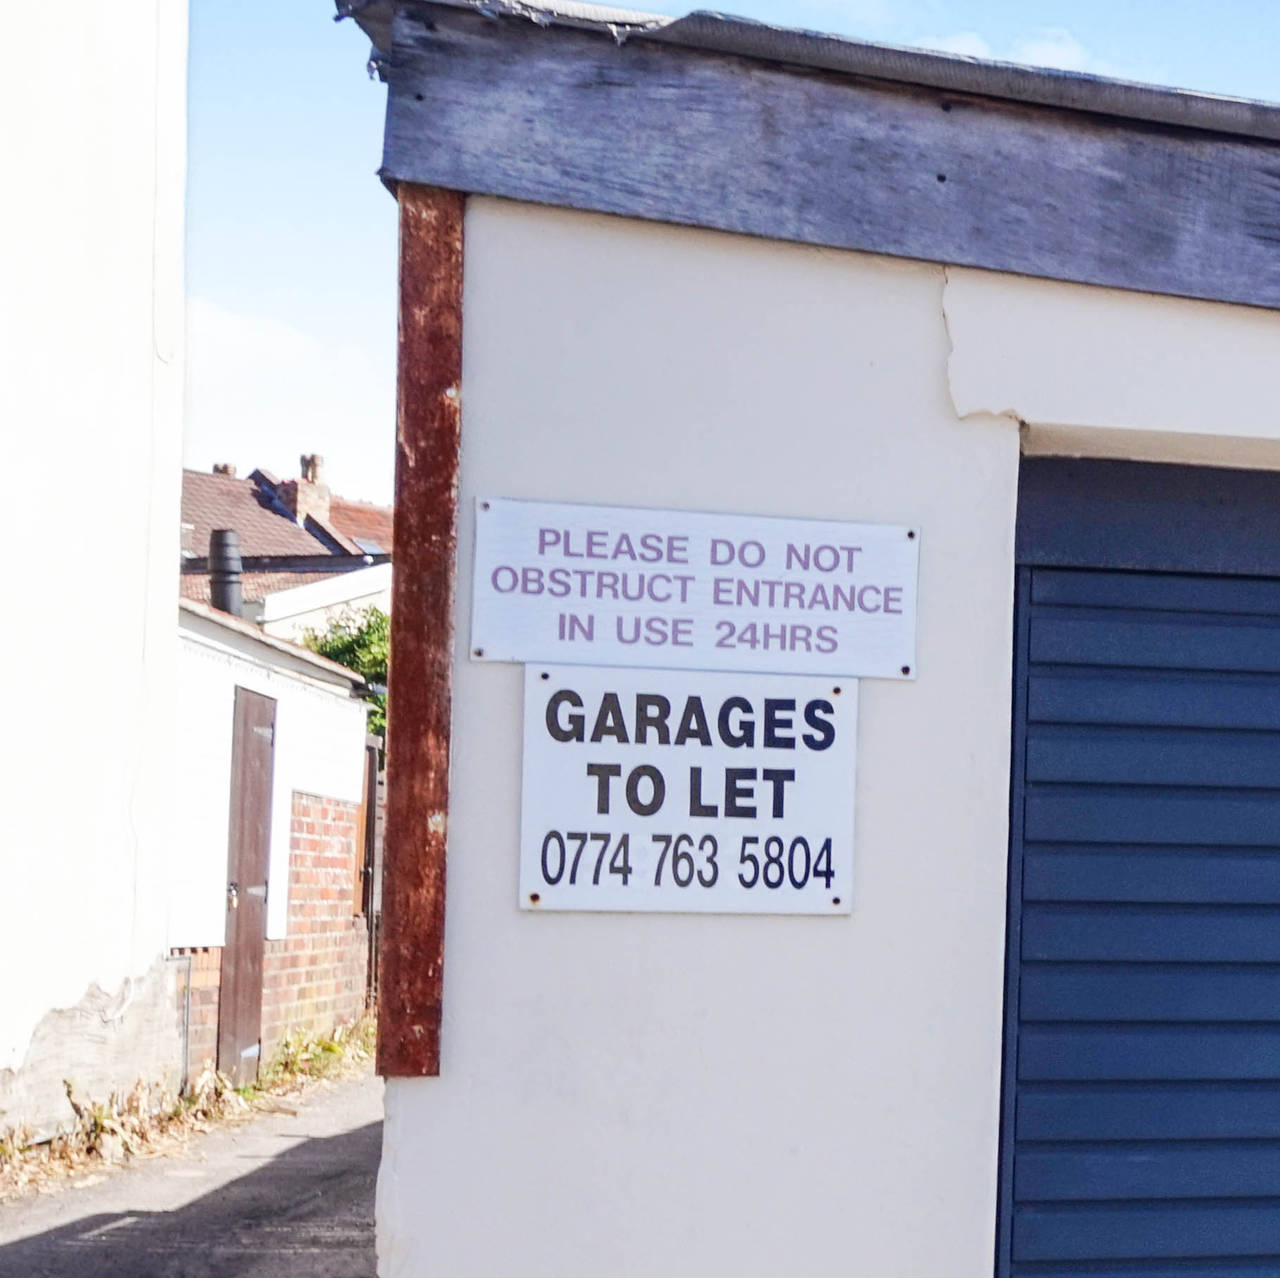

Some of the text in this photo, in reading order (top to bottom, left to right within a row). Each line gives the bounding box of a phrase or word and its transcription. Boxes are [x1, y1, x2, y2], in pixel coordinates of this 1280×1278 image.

[538, 528, 863, 573] PLEASE DO NOT
[490, 565, 903, 615] OBSTRUCT ENTRANCE
[558, 613, 838, 654] IN USE 24HRS
[545, 689, 836, 751] GARAGES
[586, 762, 796, 819] TO LET
[540, 829, 835, 890] 0774 763 5804
